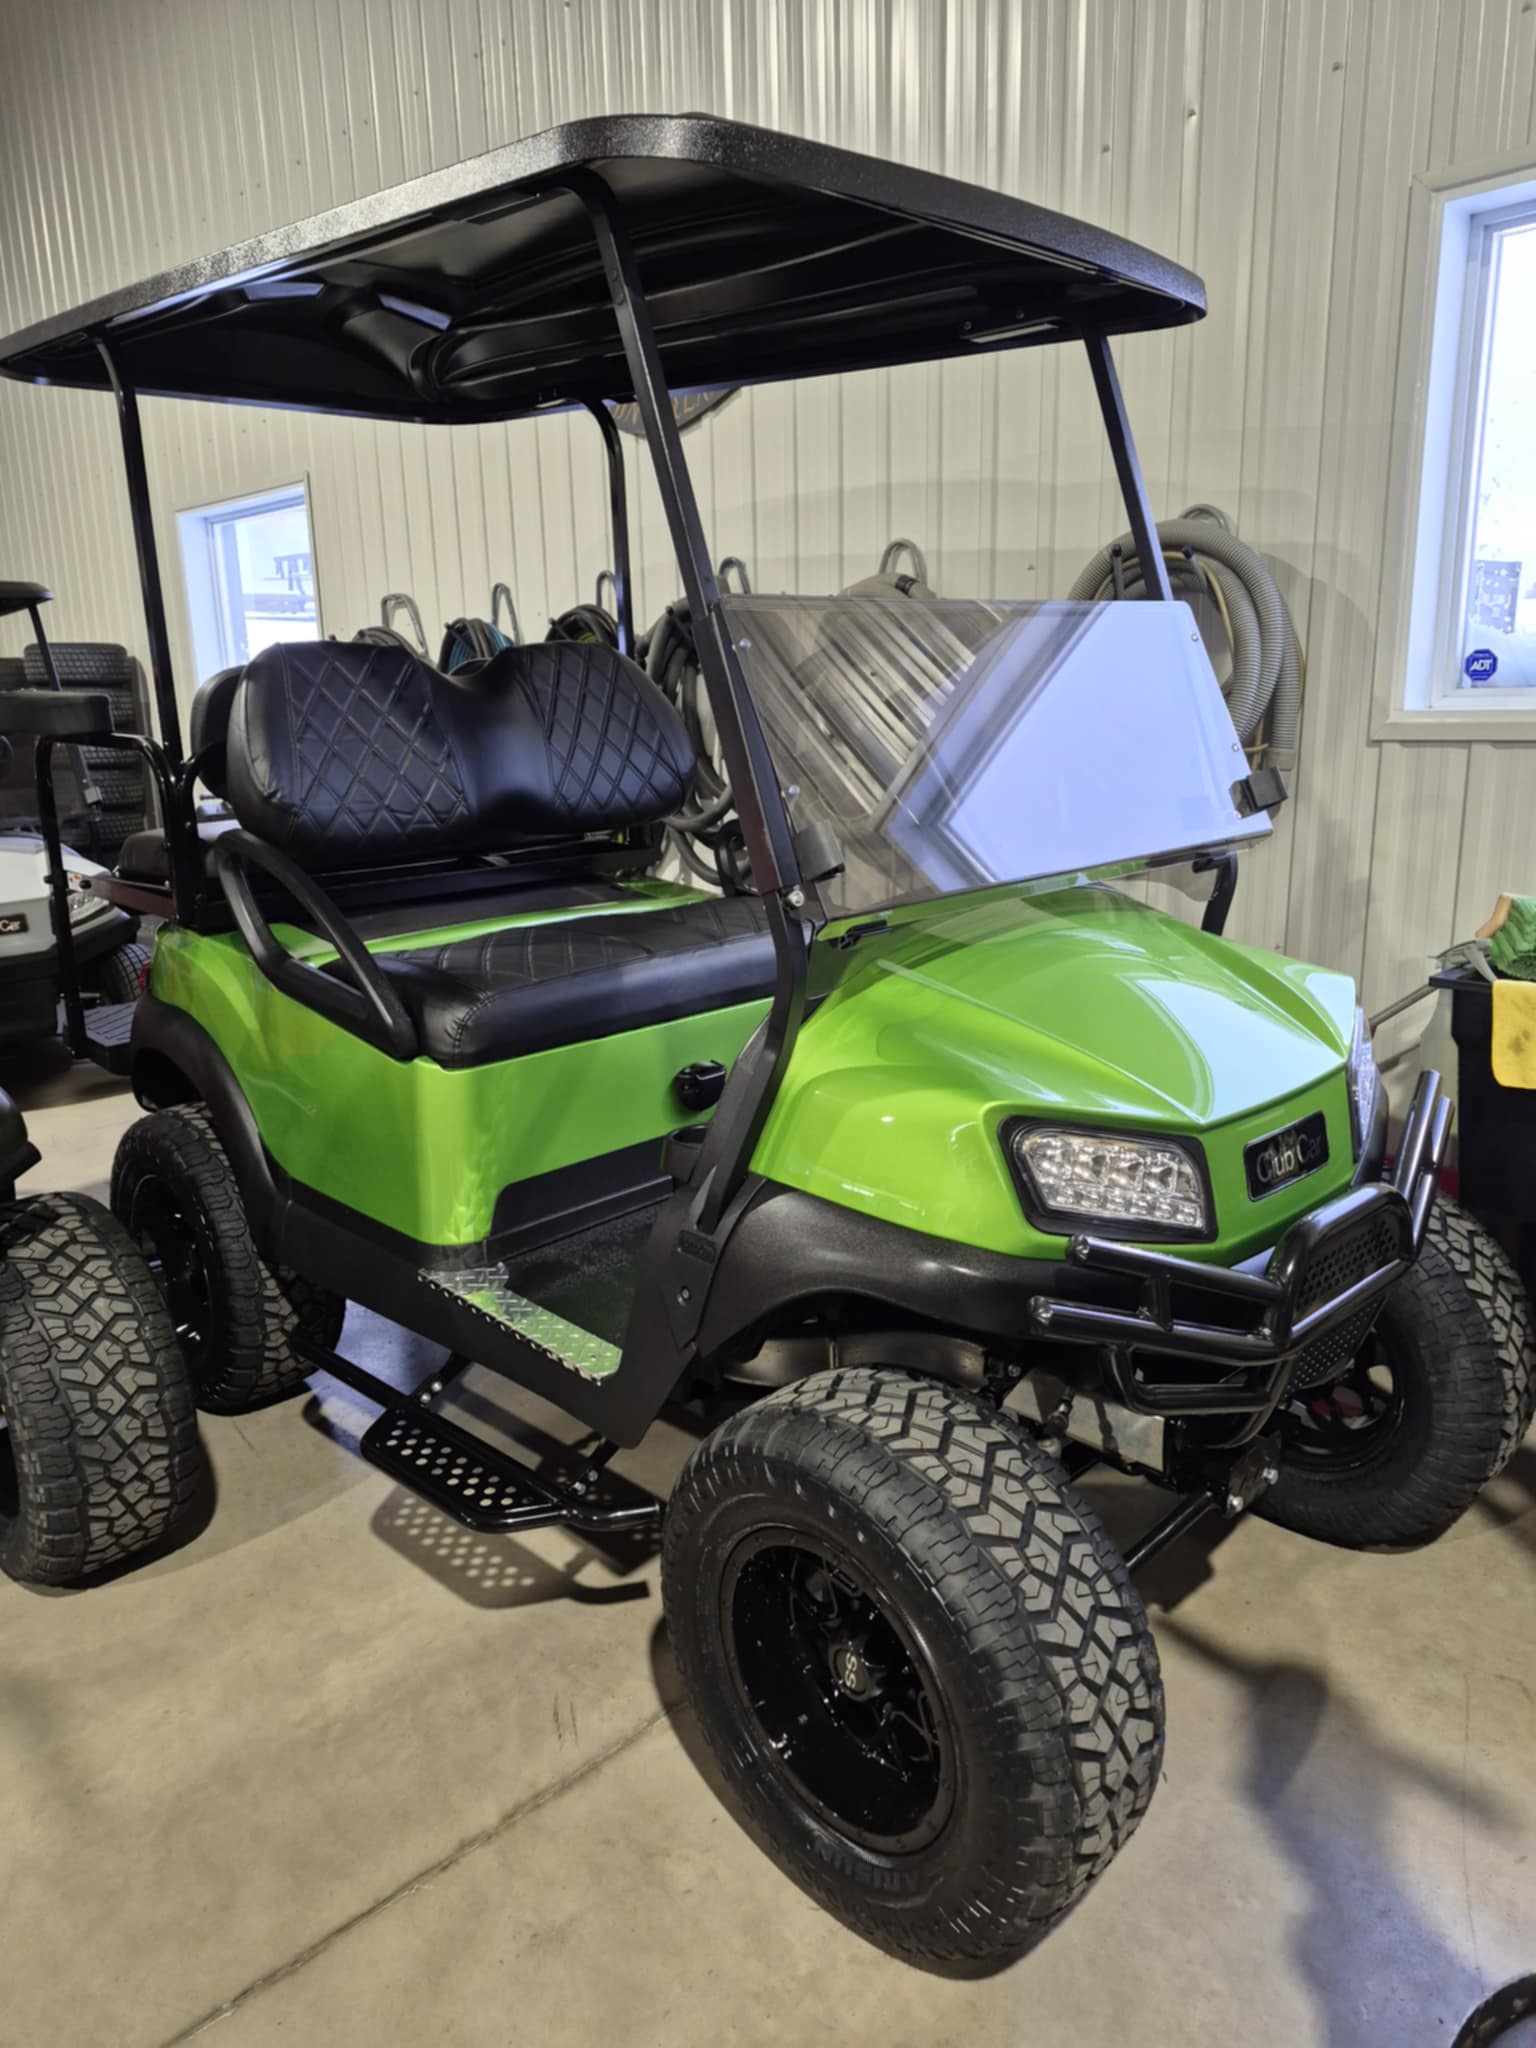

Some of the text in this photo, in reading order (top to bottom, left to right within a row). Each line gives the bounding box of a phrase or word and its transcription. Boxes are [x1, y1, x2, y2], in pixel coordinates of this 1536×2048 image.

[1470, 659, 1492, 672] ADT
[1256, 1134, 1322, 1183] Club Car
